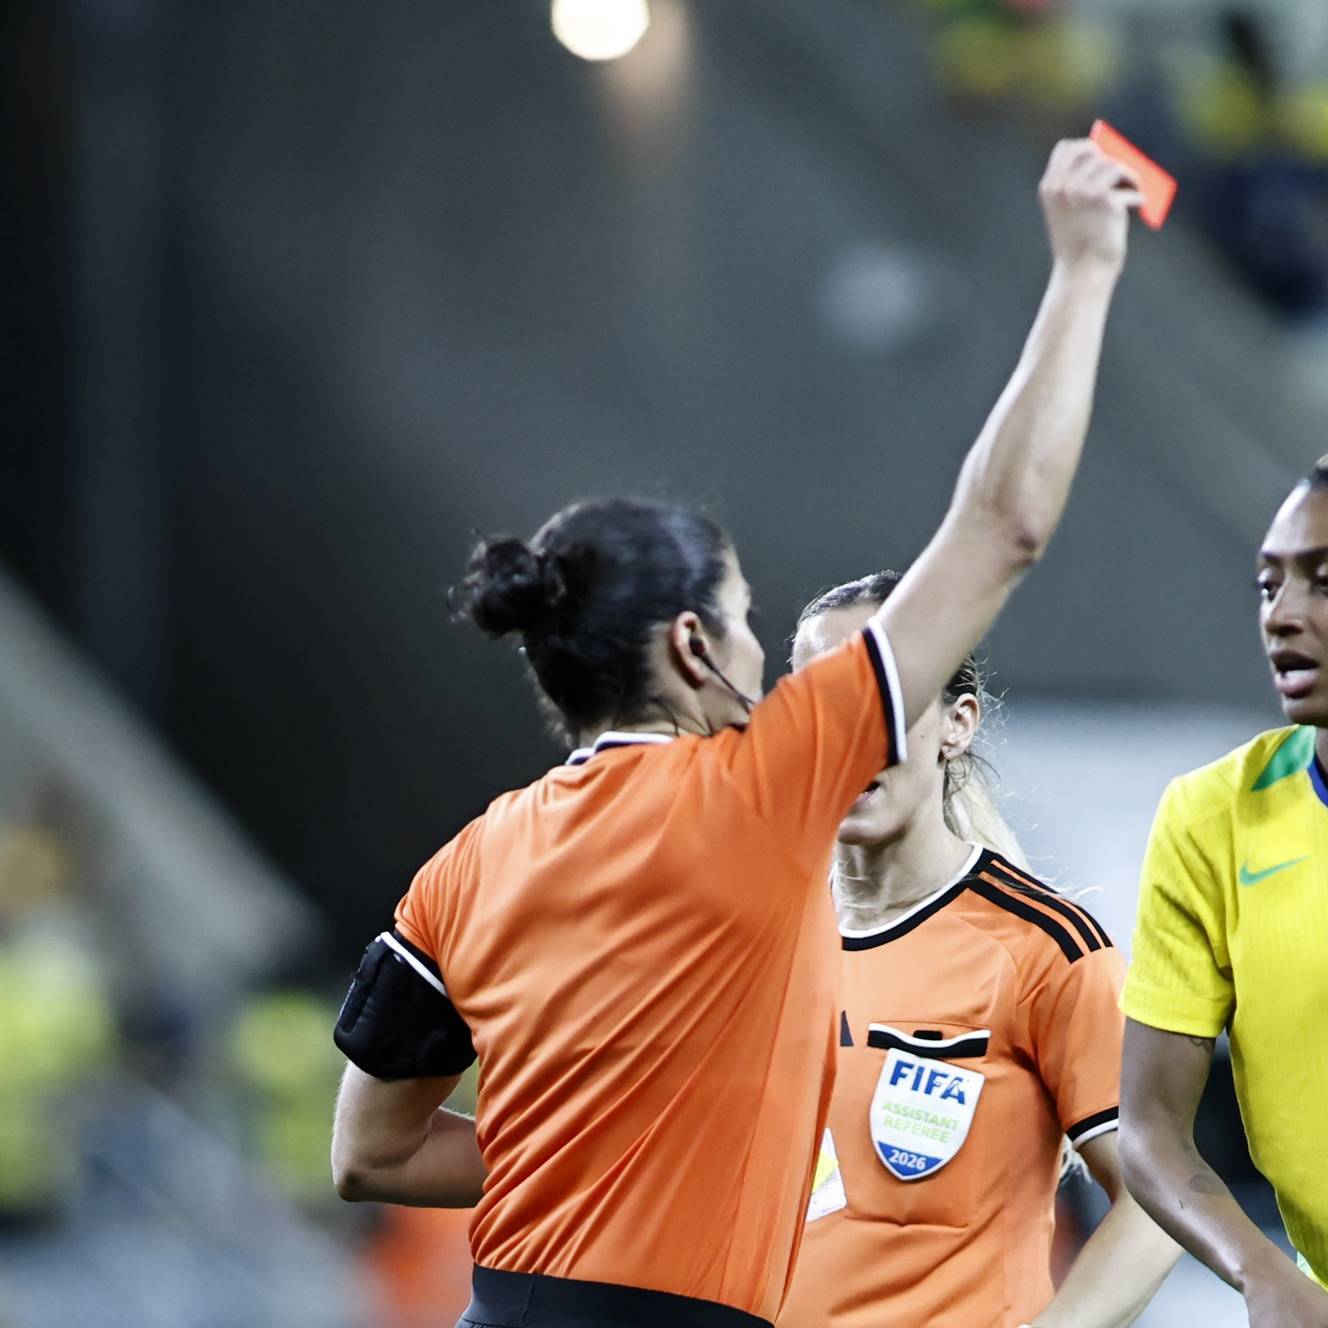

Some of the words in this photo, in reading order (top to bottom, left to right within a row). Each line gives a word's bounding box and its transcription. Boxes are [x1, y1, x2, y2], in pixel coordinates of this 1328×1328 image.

[889, 1060, 966, 1105] FIFA
[882, 1102, 960, 1130] ASSISTANT
[883, 1114, 951, 1143] REFEREE
[888, 1149, 927, 1170] 2026
